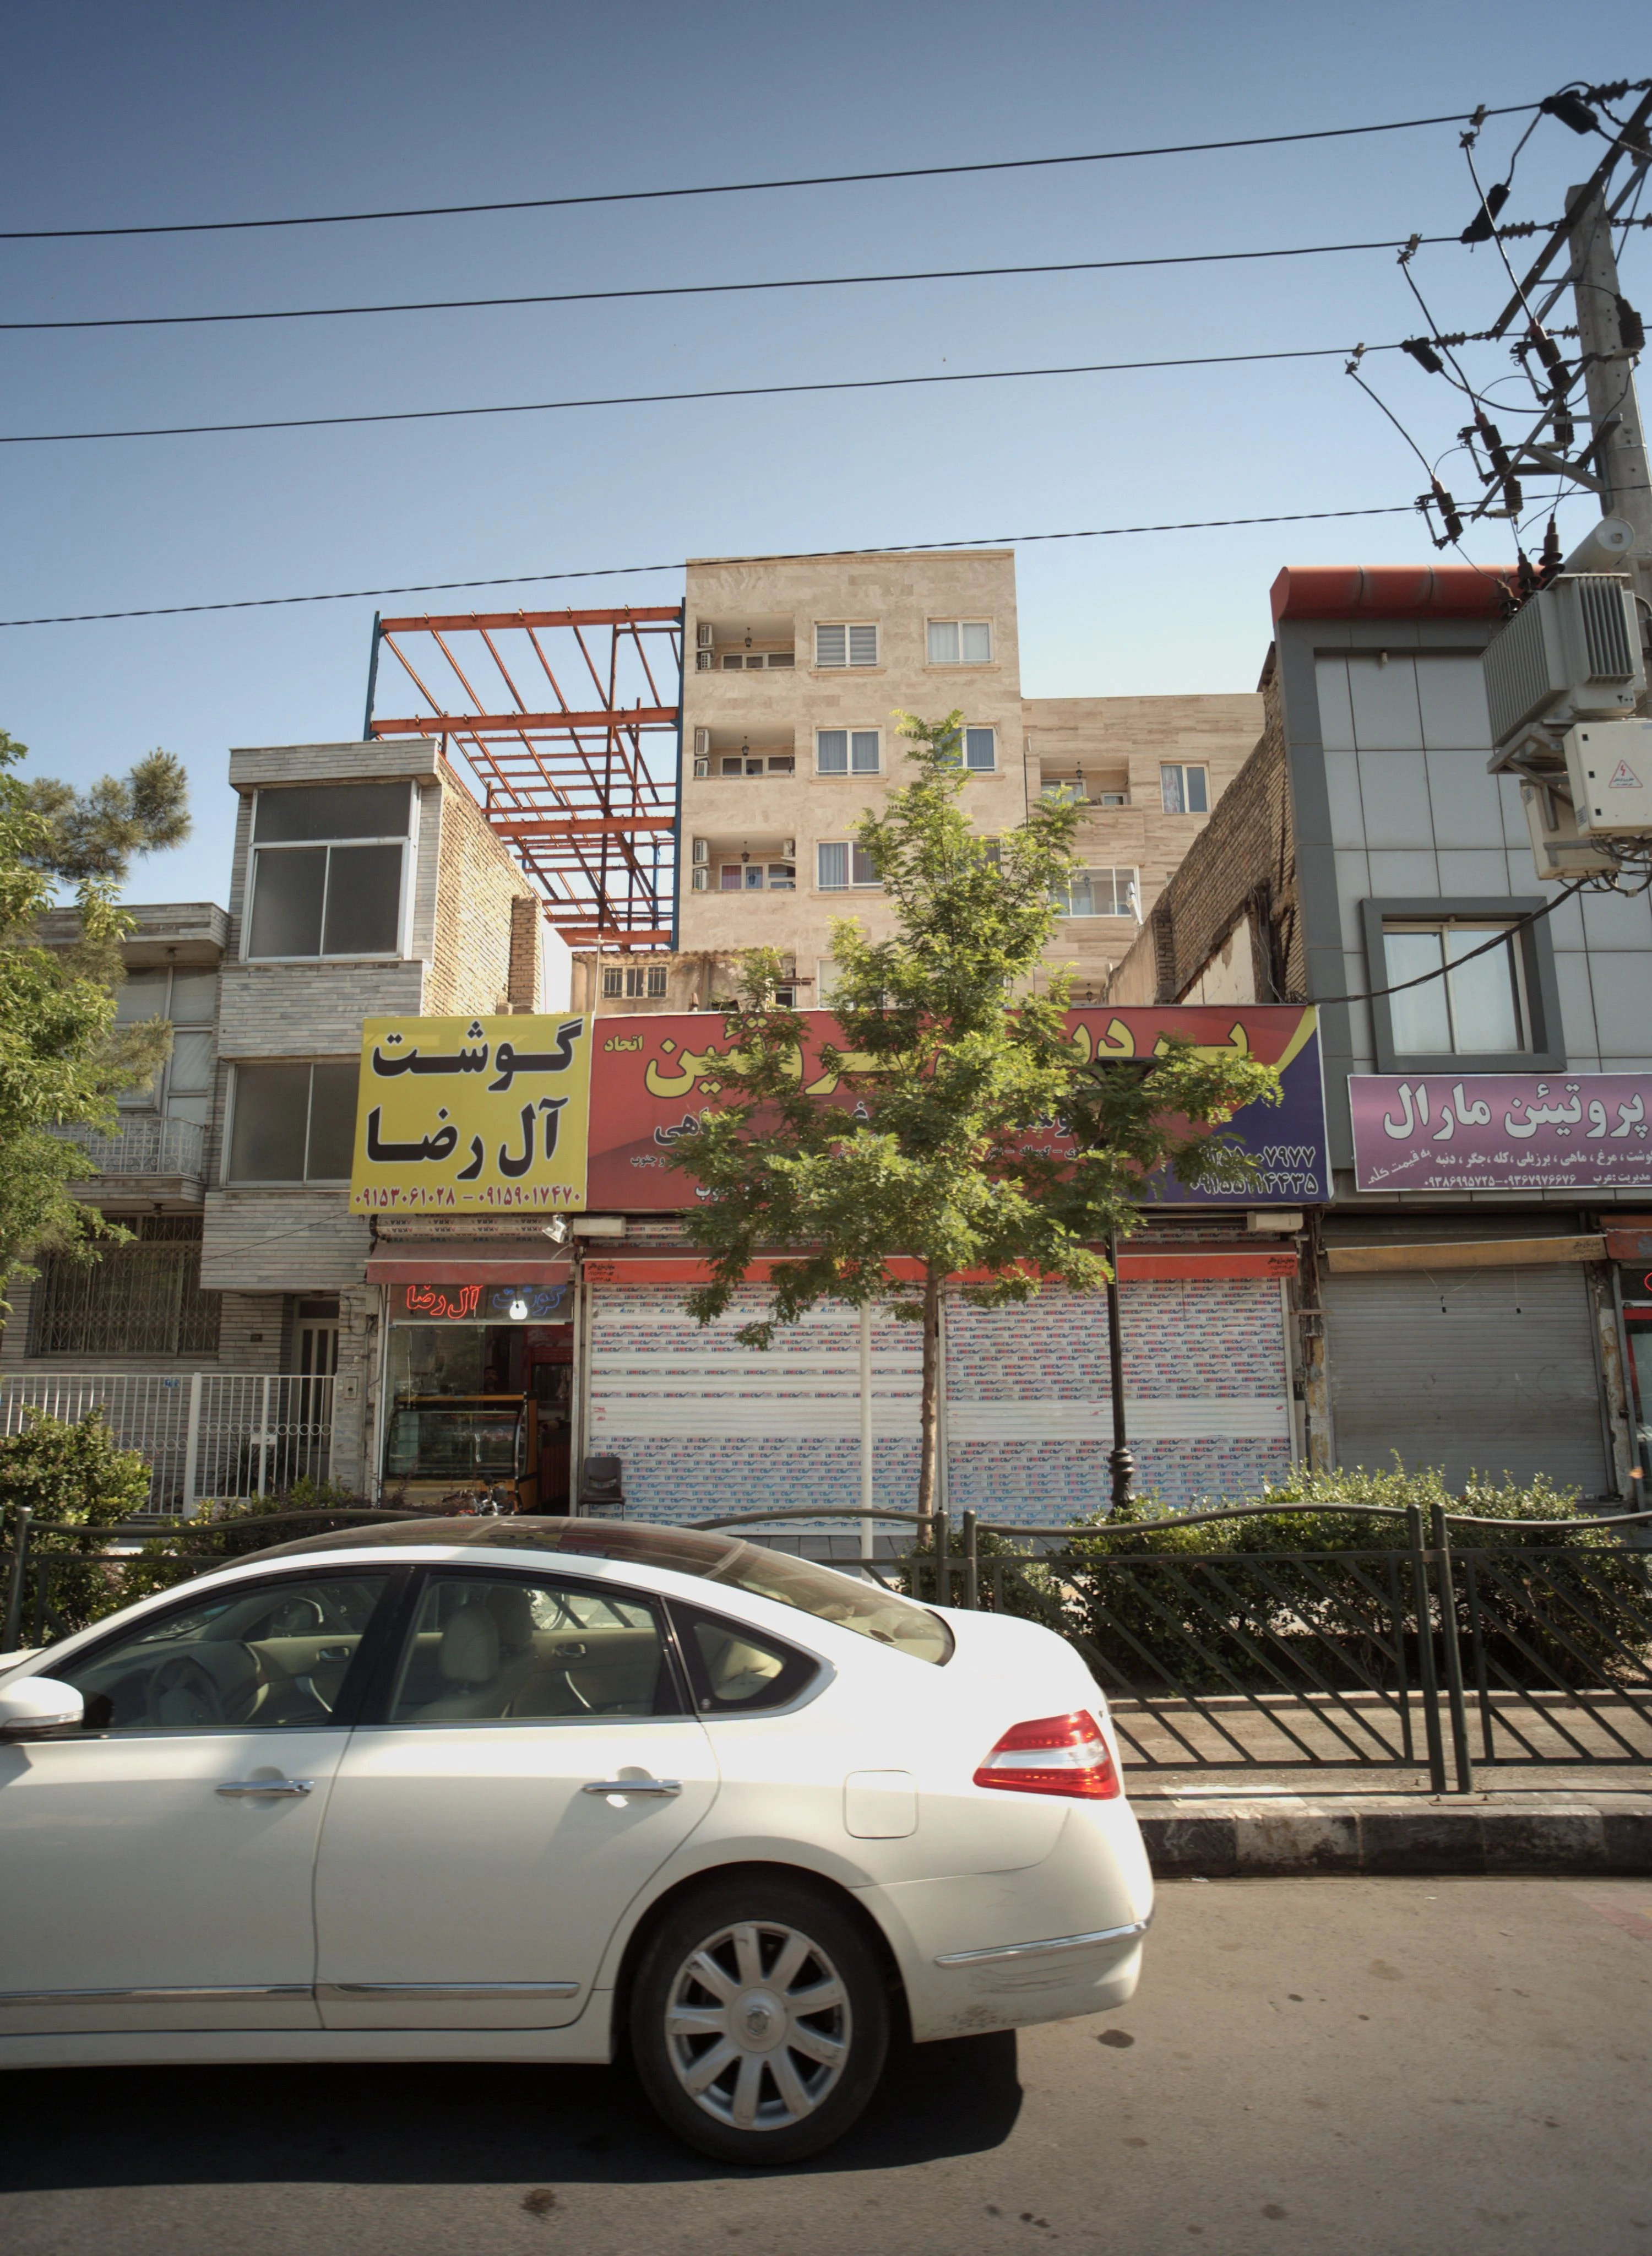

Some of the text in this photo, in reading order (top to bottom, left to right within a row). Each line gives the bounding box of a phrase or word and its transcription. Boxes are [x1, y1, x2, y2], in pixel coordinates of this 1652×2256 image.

[372, 1018, 584, 1092] گوشت
[604, 1035, 643, 1052] اتحاد
[1383, 1082, 1650, 1141] پروتئین مارال
[366, 1096, 569, 1181] آل رضا
[1391, 1149, 1420, 1173] قیمت
[1560, 1151, 1587, 1166] ماهی
[1626, 1149, 1652, 1165] وشت
[355, 1184, 582, 1208] ۰۹۱۵۹۰۱۷۴۷۰ ۰۹۱۵۳۰۶۱۰۲۸
[406, 1285, 447, 1316] رضا
[447, 1284, 483, 1319] آل
